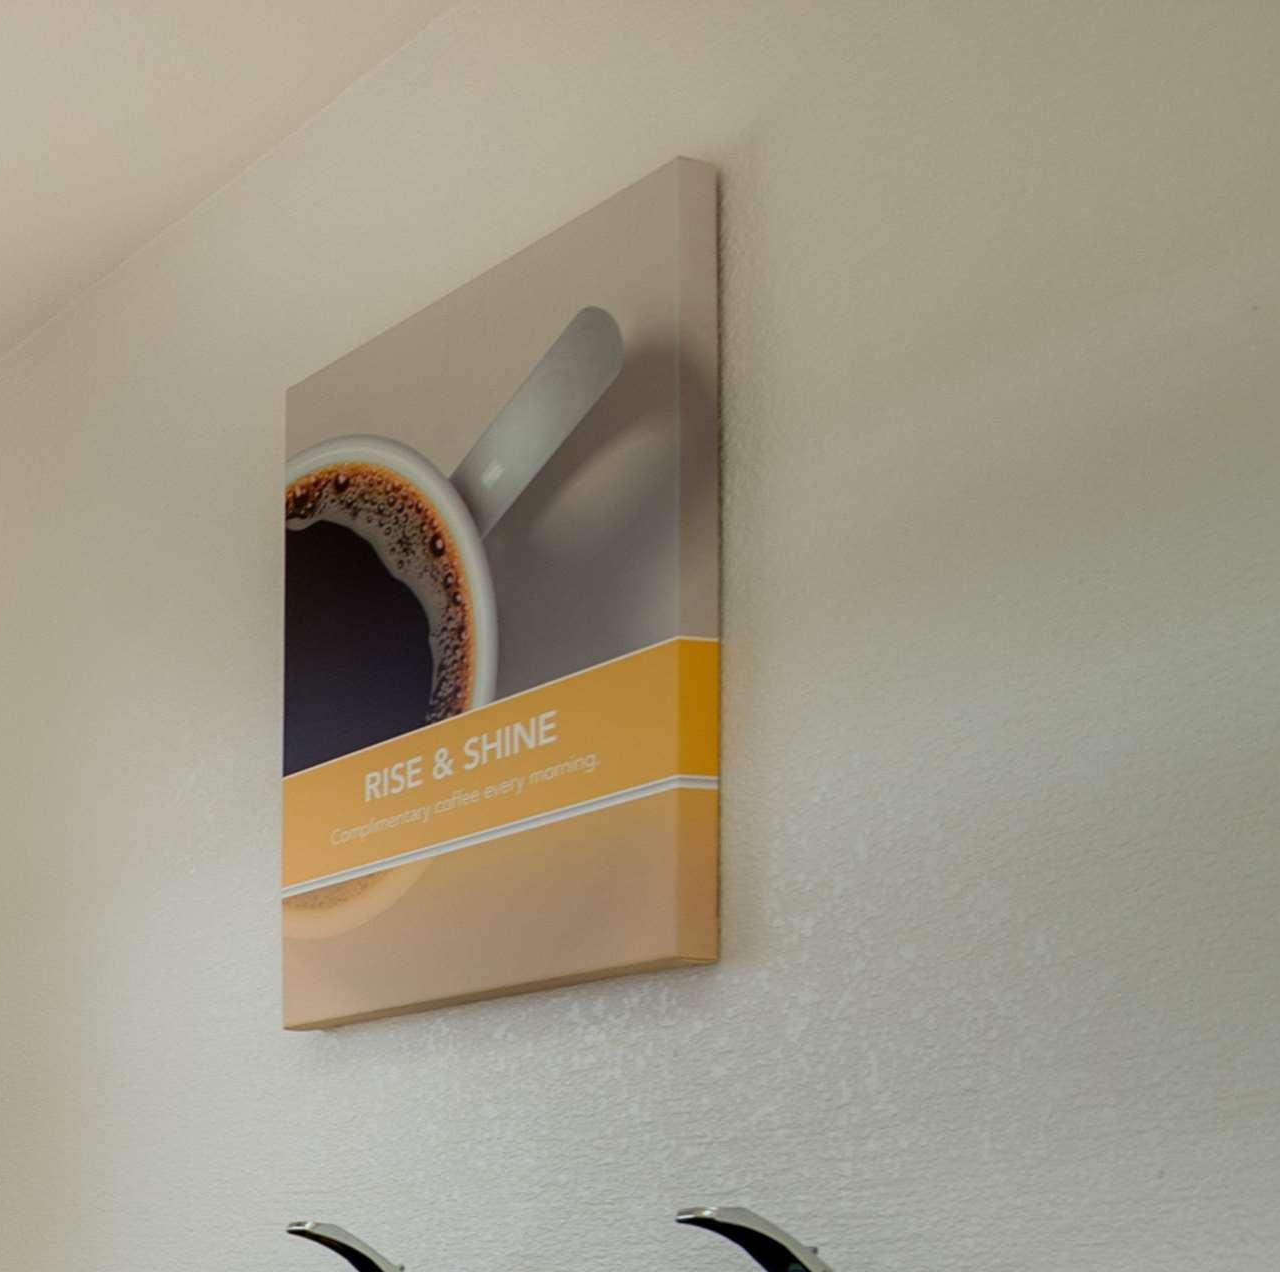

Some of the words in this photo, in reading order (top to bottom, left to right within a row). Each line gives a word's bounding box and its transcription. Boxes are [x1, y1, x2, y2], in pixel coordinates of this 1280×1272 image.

[330, 801, 432, 847] Complimentary
[433, 786, 482, 814] coffee
[483, 776, 526, 805] every
[528, 750, 601, 785] morning.
[363, 756, 424, 802] RISE
[432, 746, 456, 781] &
[462, 709, 560, 772] SHINE
